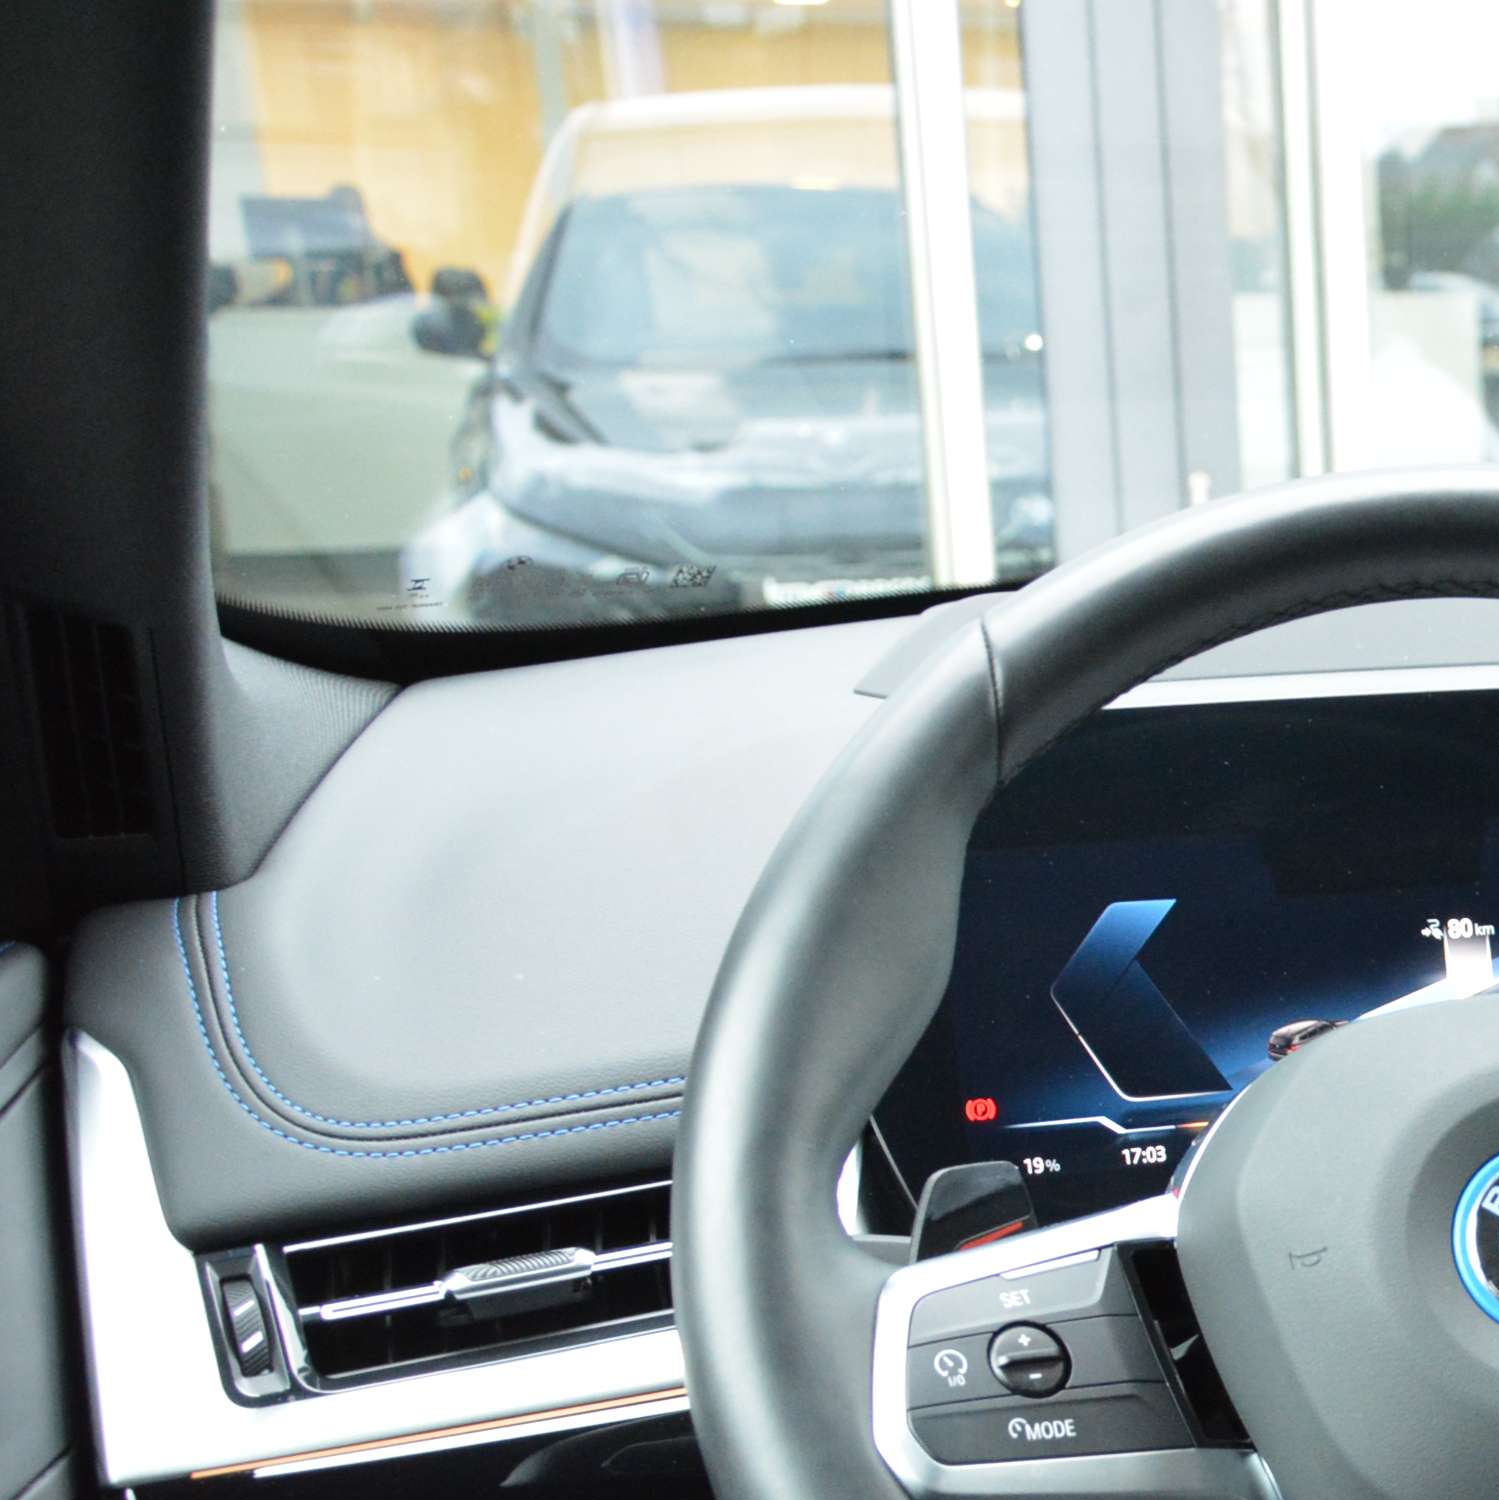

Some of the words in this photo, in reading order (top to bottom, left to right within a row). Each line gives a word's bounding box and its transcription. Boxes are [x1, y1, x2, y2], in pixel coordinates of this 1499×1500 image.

[1447, 917, 1474, 939] 80
[1474, 922, 1496, 937] km
[1022, 1156, 1061, 1175] 19%
[1121, 1145, 1167, 1166] 17:03
[1000, 1289, 1032, 1309] SET
[1024, 1419, 1077, 1442] MODE
